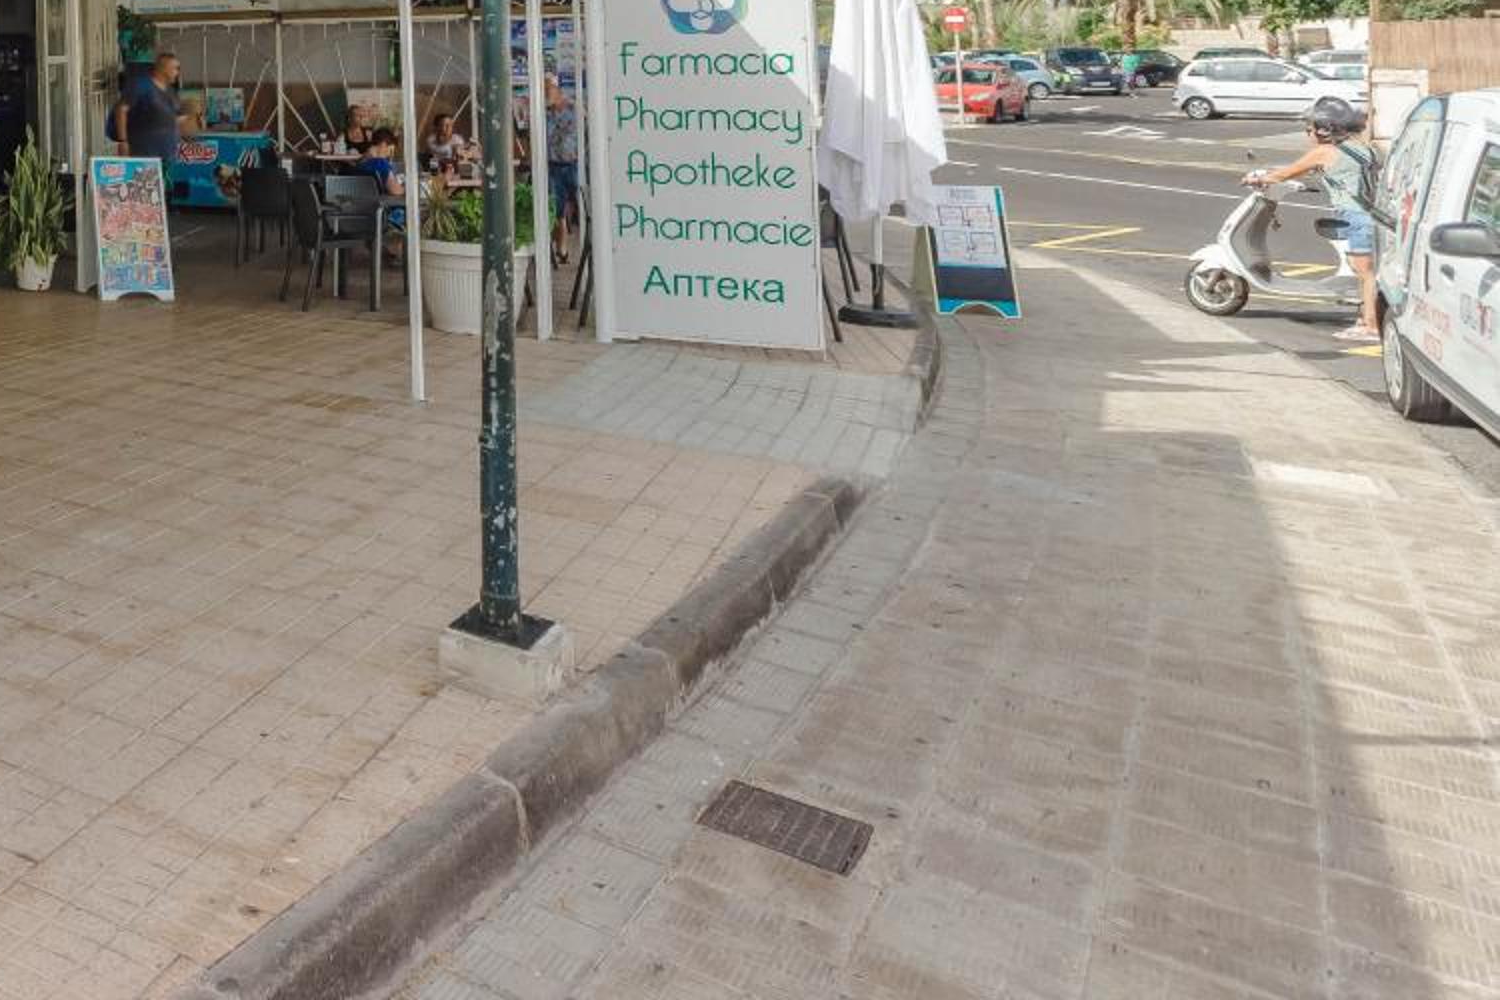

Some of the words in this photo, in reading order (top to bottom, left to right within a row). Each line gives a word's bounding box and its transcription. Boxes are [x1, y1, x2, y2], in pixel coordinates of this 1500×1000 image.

[618, 41, 795, 77] Farmacia
[614, 95, 804, 145] Pharmacy
[626, 149, 797, 198] Apotheke
[615, 203, 812, 247] Pharmacie
[643, 264, 786, 304] Аптека
